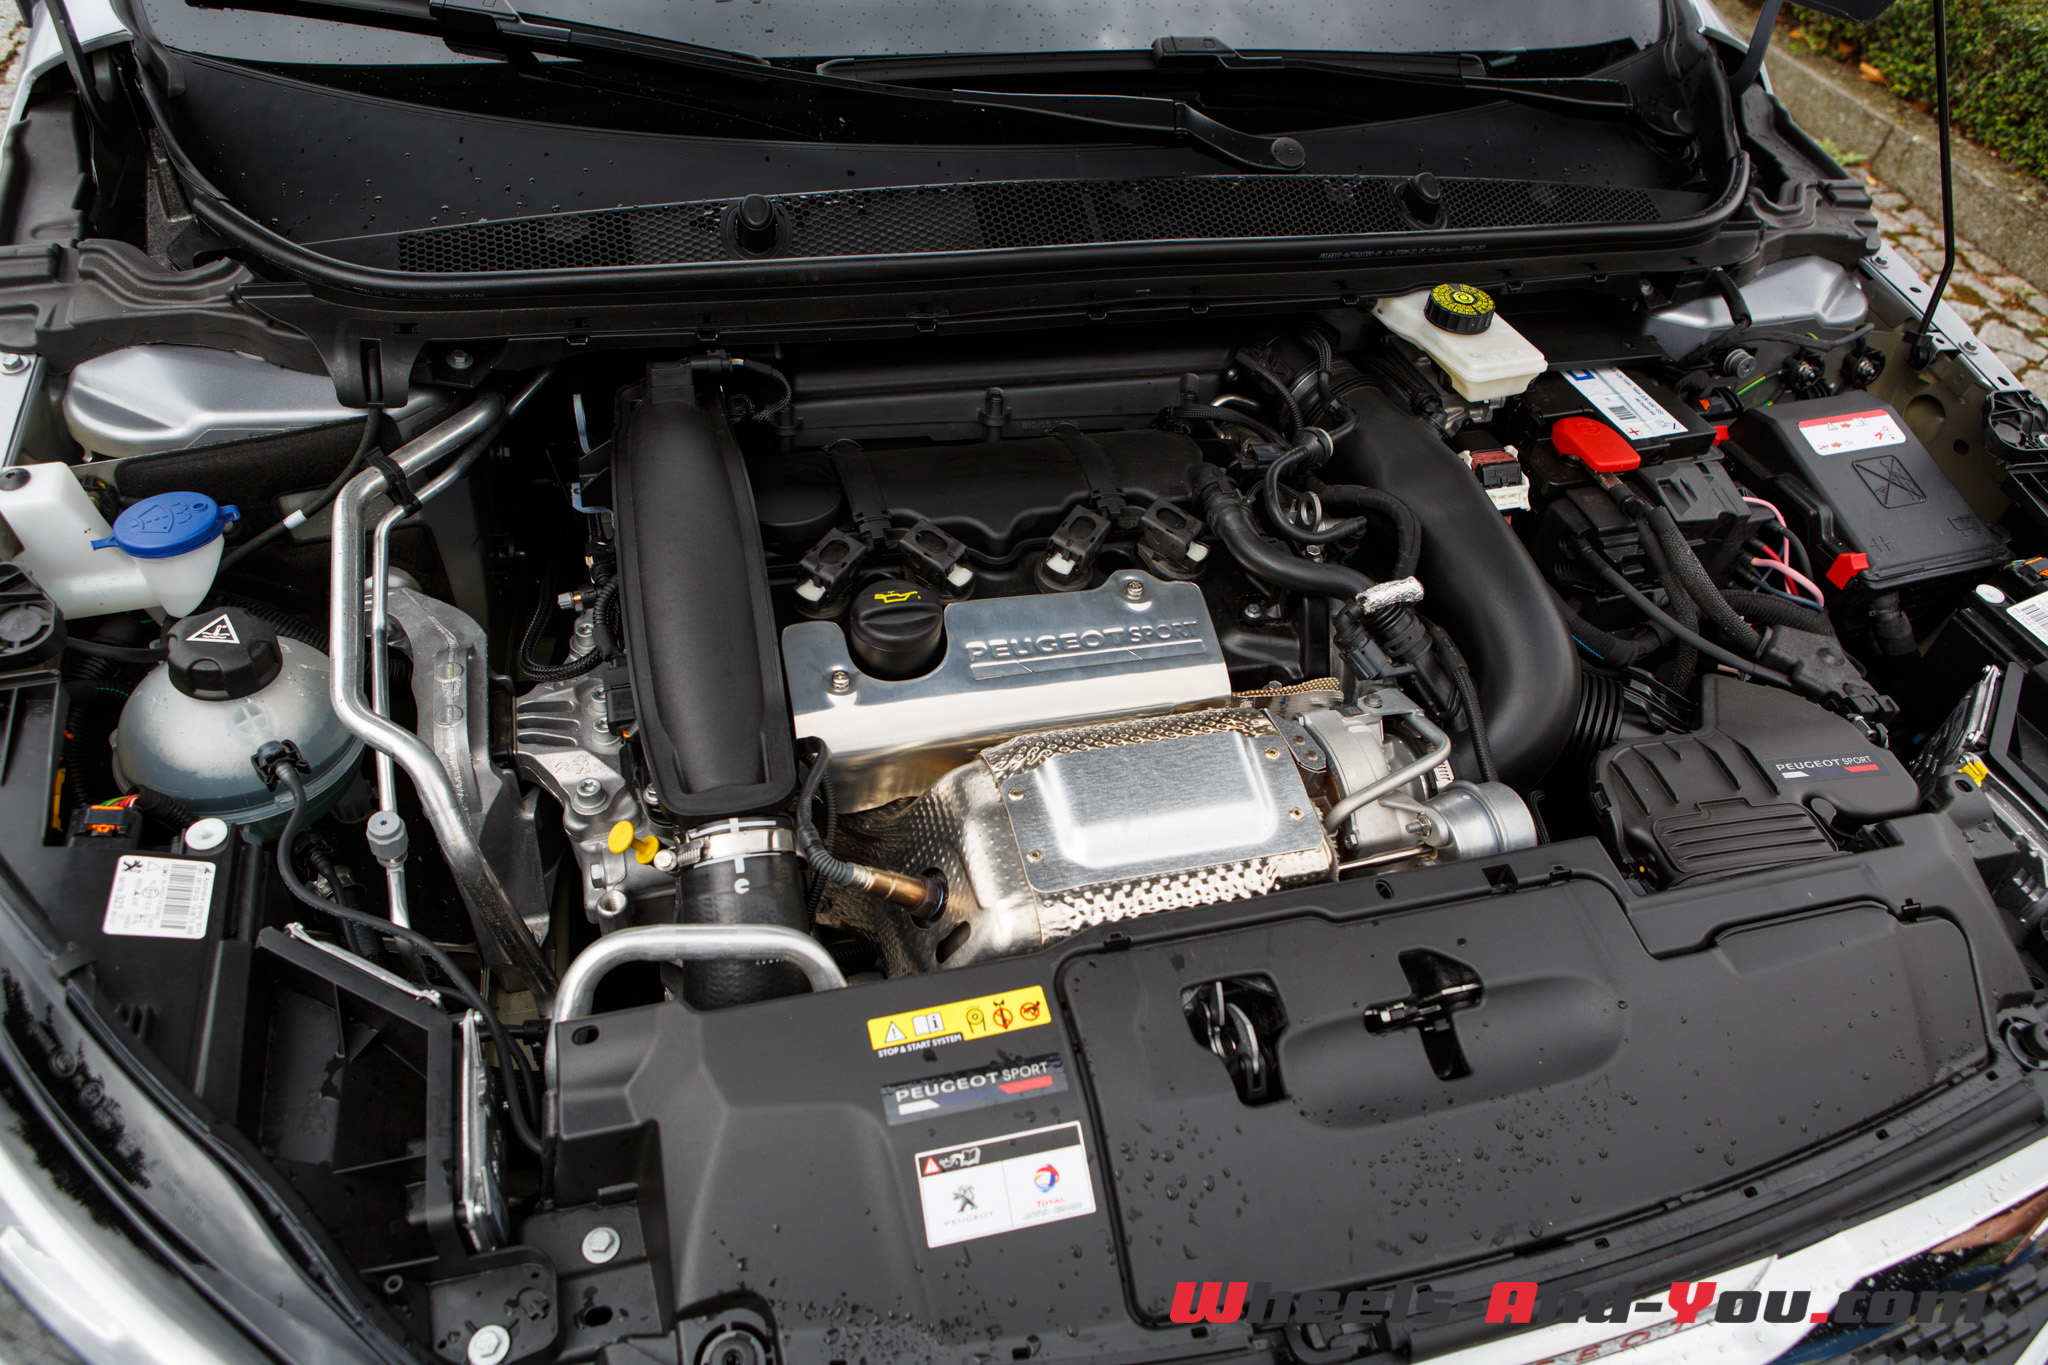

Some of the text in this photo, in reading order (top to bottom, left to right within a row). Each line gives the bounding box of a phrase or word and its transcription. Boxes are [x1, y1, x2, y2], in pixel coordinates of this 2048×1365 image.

[966, 621, 1197, 661] PEUGEOT SPORT
[1775, 755, 1872, 771] PEUGEOT SPORT
[878, 1046, 899, 1058] STOP
[906, 1040, 931, 1052] START
[932, 1034, 962, 1047] SYSTEM
[895, 1062, 1049, 1102] PEUGEOT SPORT
[944, 1211, 994, 1227] PEUGEOT
